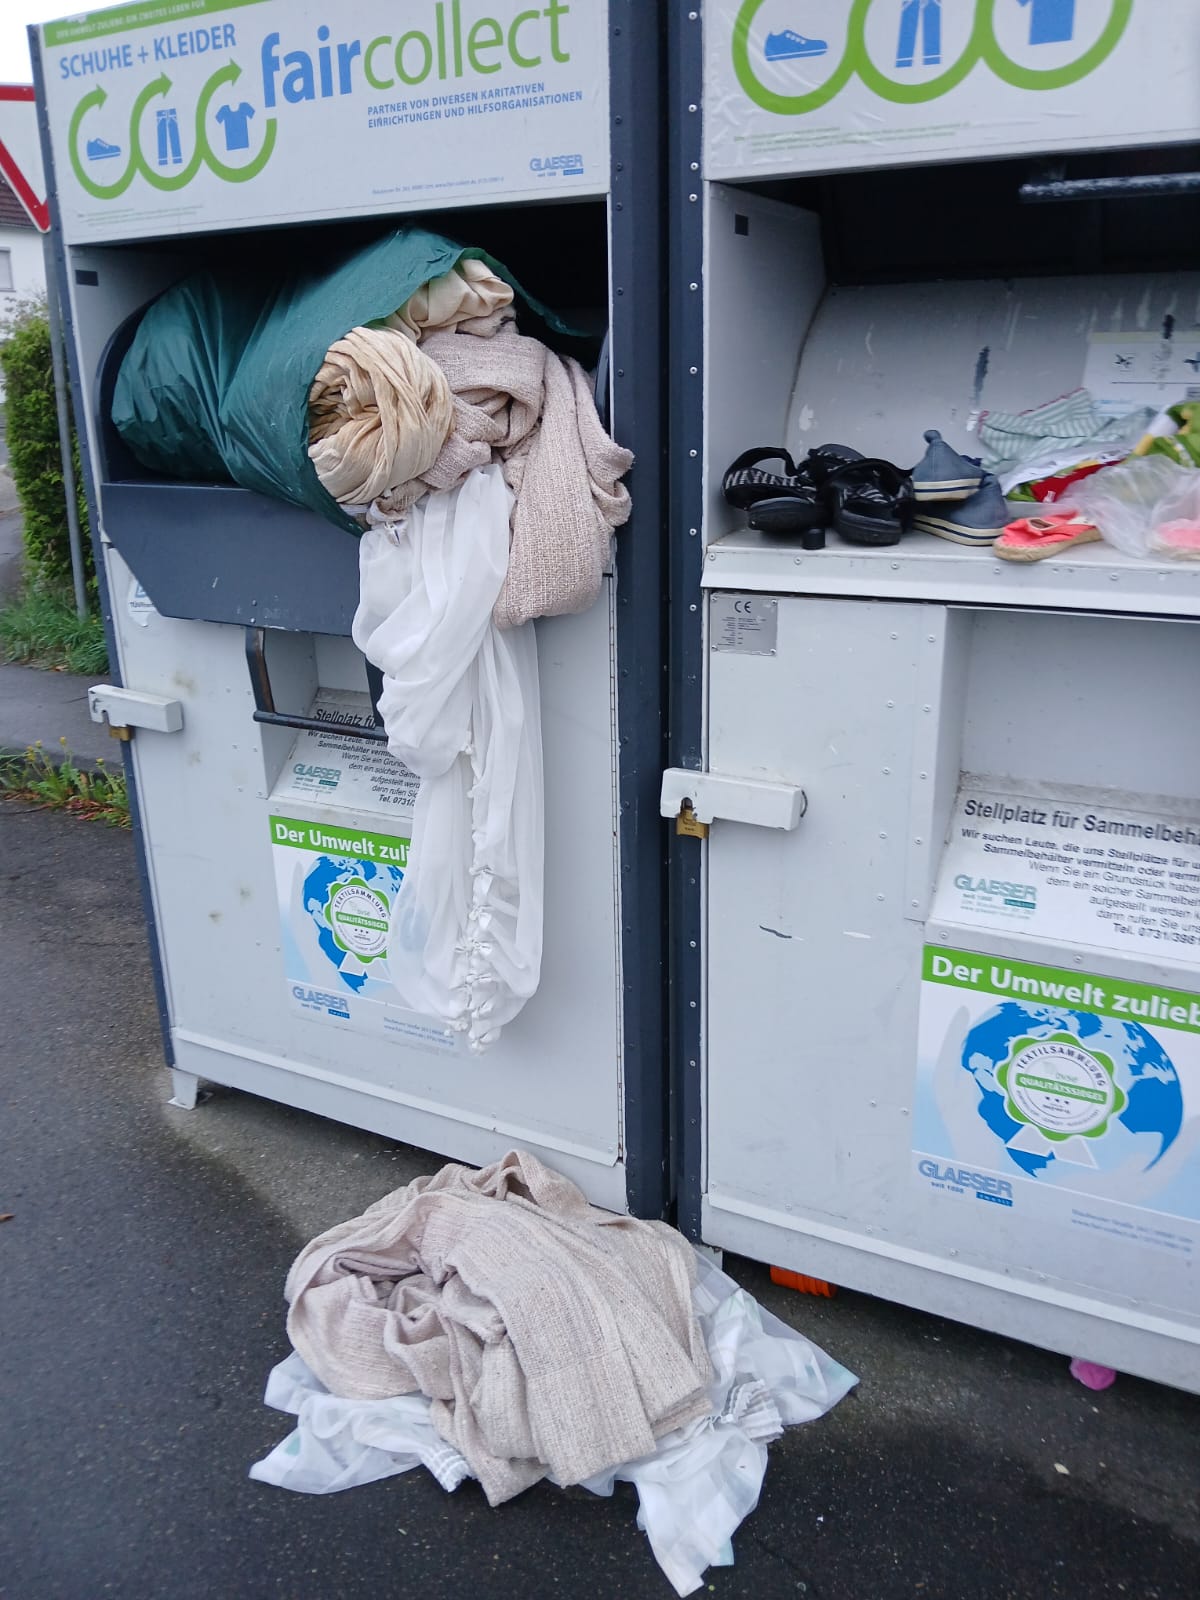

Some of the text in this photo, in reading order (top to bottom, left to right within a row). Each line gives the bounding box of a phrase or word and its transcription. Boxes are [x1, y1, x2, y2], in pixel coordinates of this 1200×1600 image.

[59, 23, 237, 80] SCHUHE + KLEIDER
[261, 0, 570, 108] faircollect
[367, 82, 545, 116] PARTNER VON DIVERSEN KARITATIVEN
[368, 90, 583, 128] EINRICHTUNGEN UND HILFSORGANISATIONEN
[530, 154, 583, 171] GLAESER
[314, 708, 376, 729] Stellplatz fü
[349, 762, 363, 770] dem
[375, 766, 399, 776] solcher
[360, 754, 371, 762] Sie
[293, 763, 341, 781] GLAESER
[404, 780, 421, 789] werd
[372, 785, 388, 793] dann
[389, 788, 406, 796] rufen
[379, 794, 391, 803] Tel.
[964, 799, 1200, 846] Stellplatz für Sammelbeh
[275, 823, 410, 862] Der Umwelt zul
[961, 828, 981, 838] Wir
[982, 833, 1022, 845] suchen
[1062, 842, 1080, 853] die
[1083, 846, 1104, 857] uns
[1107, 848, 1168, 865] Stellplätze
[1172, 857, 1190, 868] für
[983, 843, 1074, 864] Sammelbehälter
[1077, 858, 1135, 872] vermitteln
[1137, 864, 1165, 877] oder
[954, 873, 1037, 901] GLAESER
[1028, 860, 1060, 873] Wenn
[1062, 865, 1081, 876] Sie
[1083, 869, 1100, 879] ein
[1103, 871, 1165, 889] Grundstück
[1046, 876, 1070, 888] dem
[1072, 880, 1091, 891] ein
[1092, 884, 1133, 897] solcher
[1089, 895, 1146, 911] aufgestellt
[1149, 905, 1191, 918] werden
[1096, 908, 1125, 921] dann
[1127, 914, 1157, 926] rufen
[1160, 918, 1178, 929] Sie
[1113, 922, 1134, 935] Tel.
[293, 986, 349, 1012] GLAESER
[931, 954, 1200, 1028] Der Umwelt zulieb
[1016, 1045, 1106, 1087] TEXTILSAMMLUNG
[918, 1159, 1013, 1199] GLAESER
